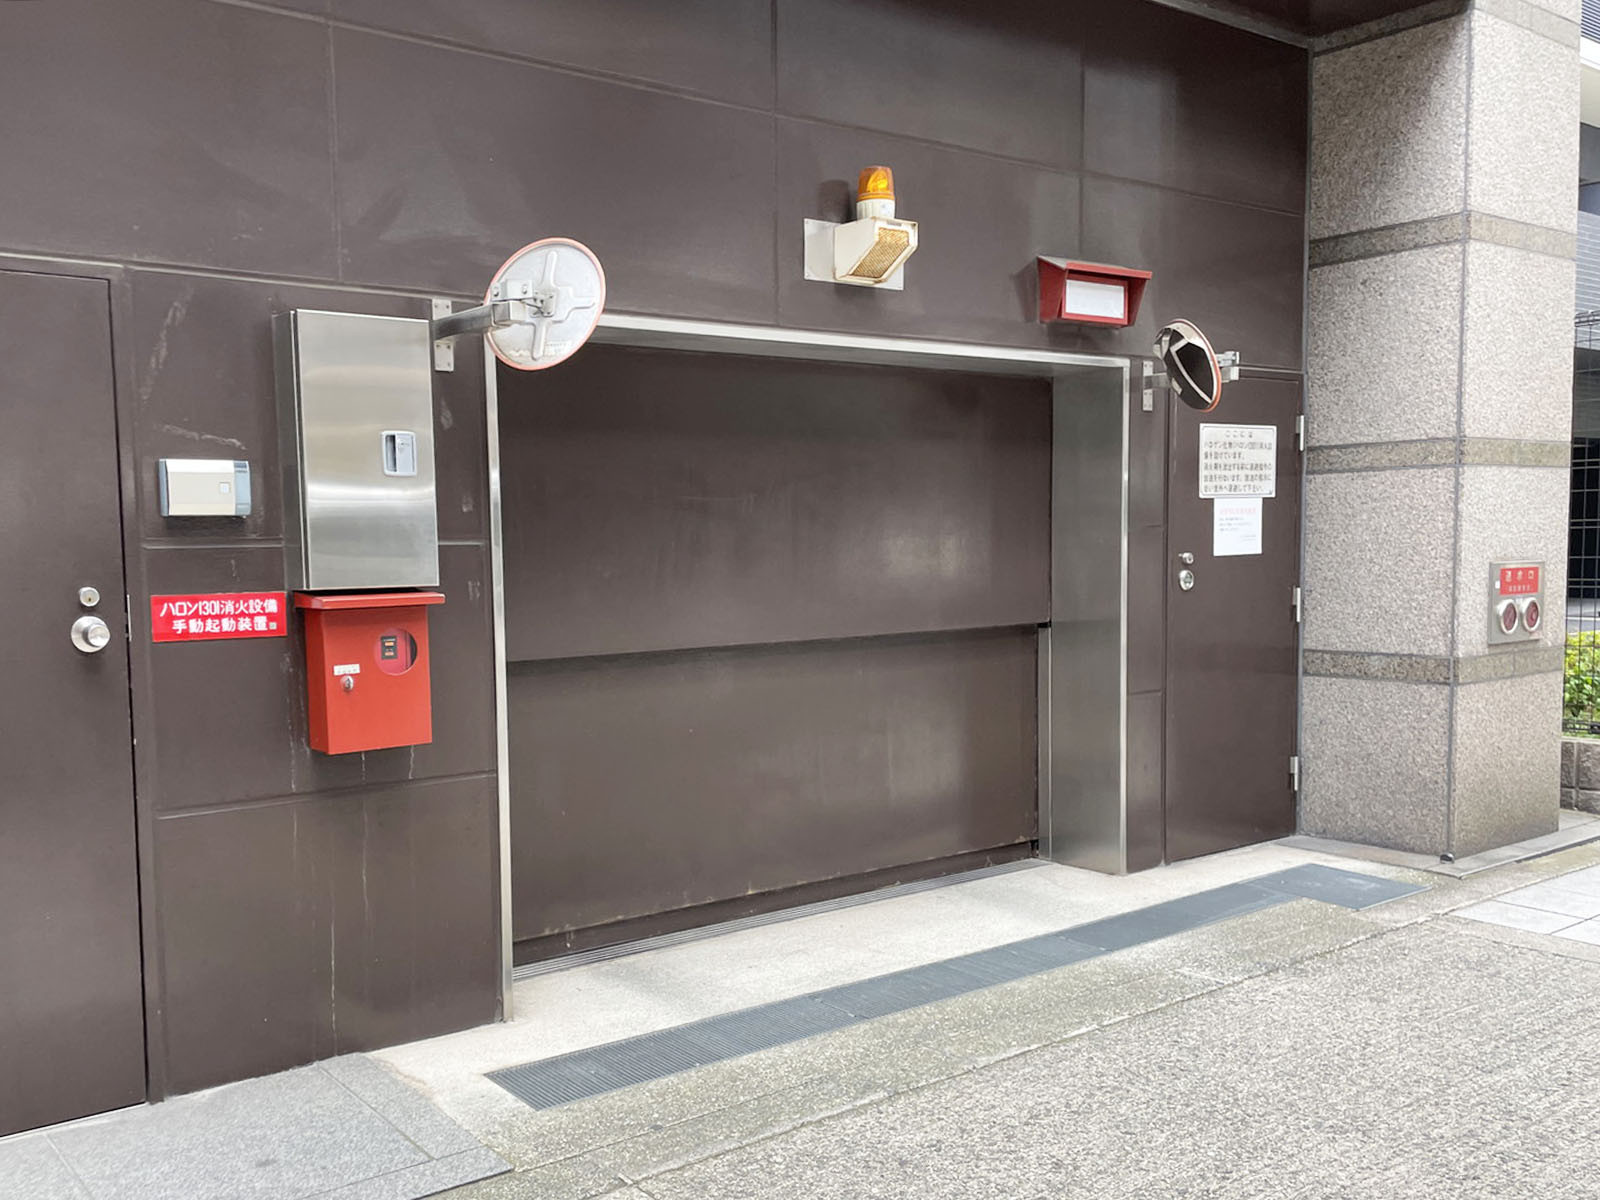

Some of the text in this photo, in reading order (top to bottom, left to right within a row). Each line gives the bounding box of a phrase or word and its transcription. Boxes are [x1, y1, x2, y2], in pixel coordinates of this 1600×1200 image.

[159, 598, 279, 617] ハロン1301消火設備
[171, 615, 268, 634] 手動起動装置
